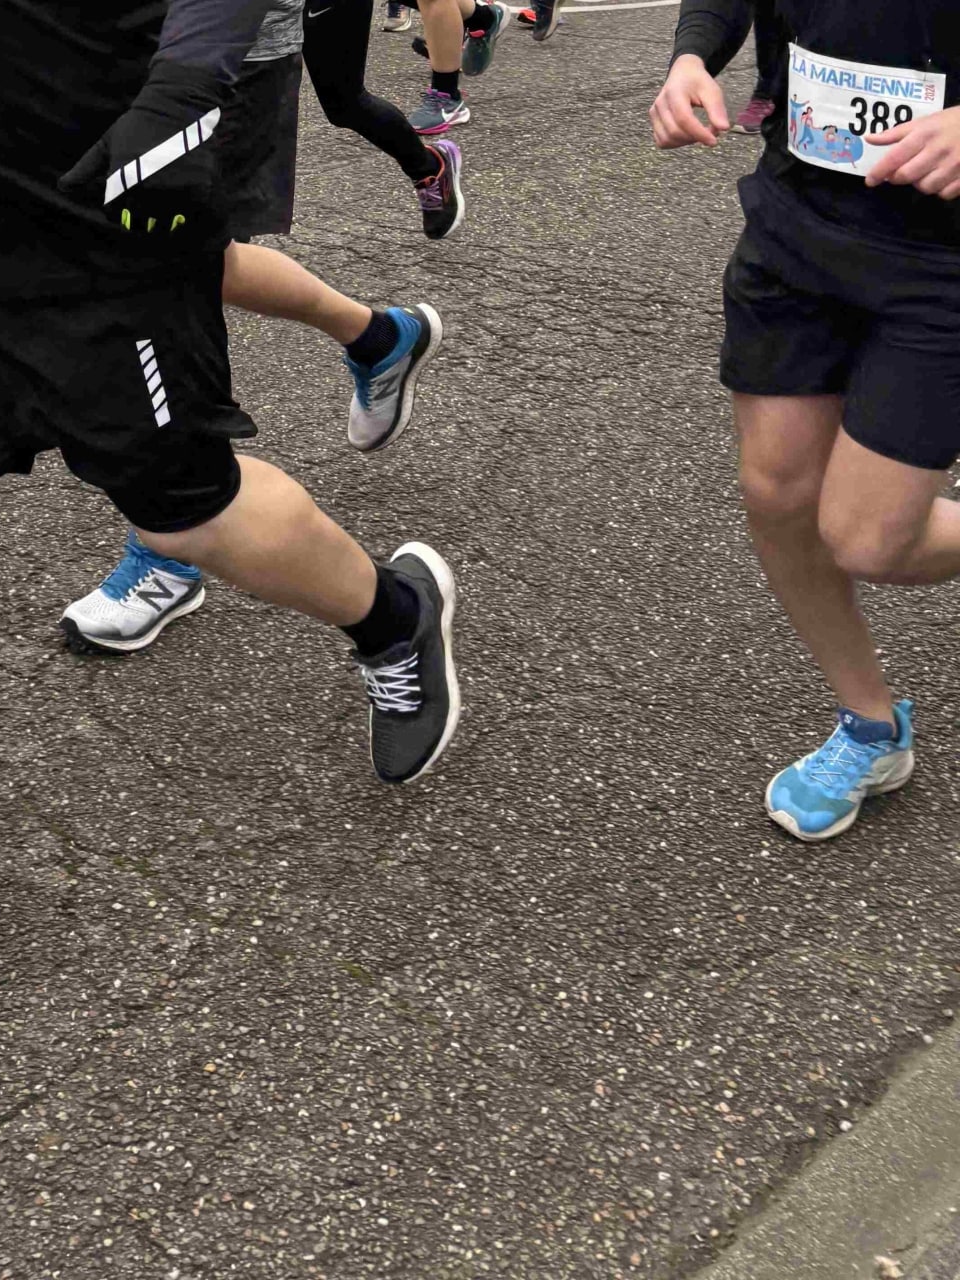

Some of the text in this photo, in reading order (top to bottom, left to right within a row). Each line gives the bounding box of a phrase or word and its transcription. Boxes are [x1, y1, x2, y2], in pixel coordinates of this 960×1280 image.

[792, 52, 924, 100] LA MARLIENNE
[924, 83, 936, 102] 2024
